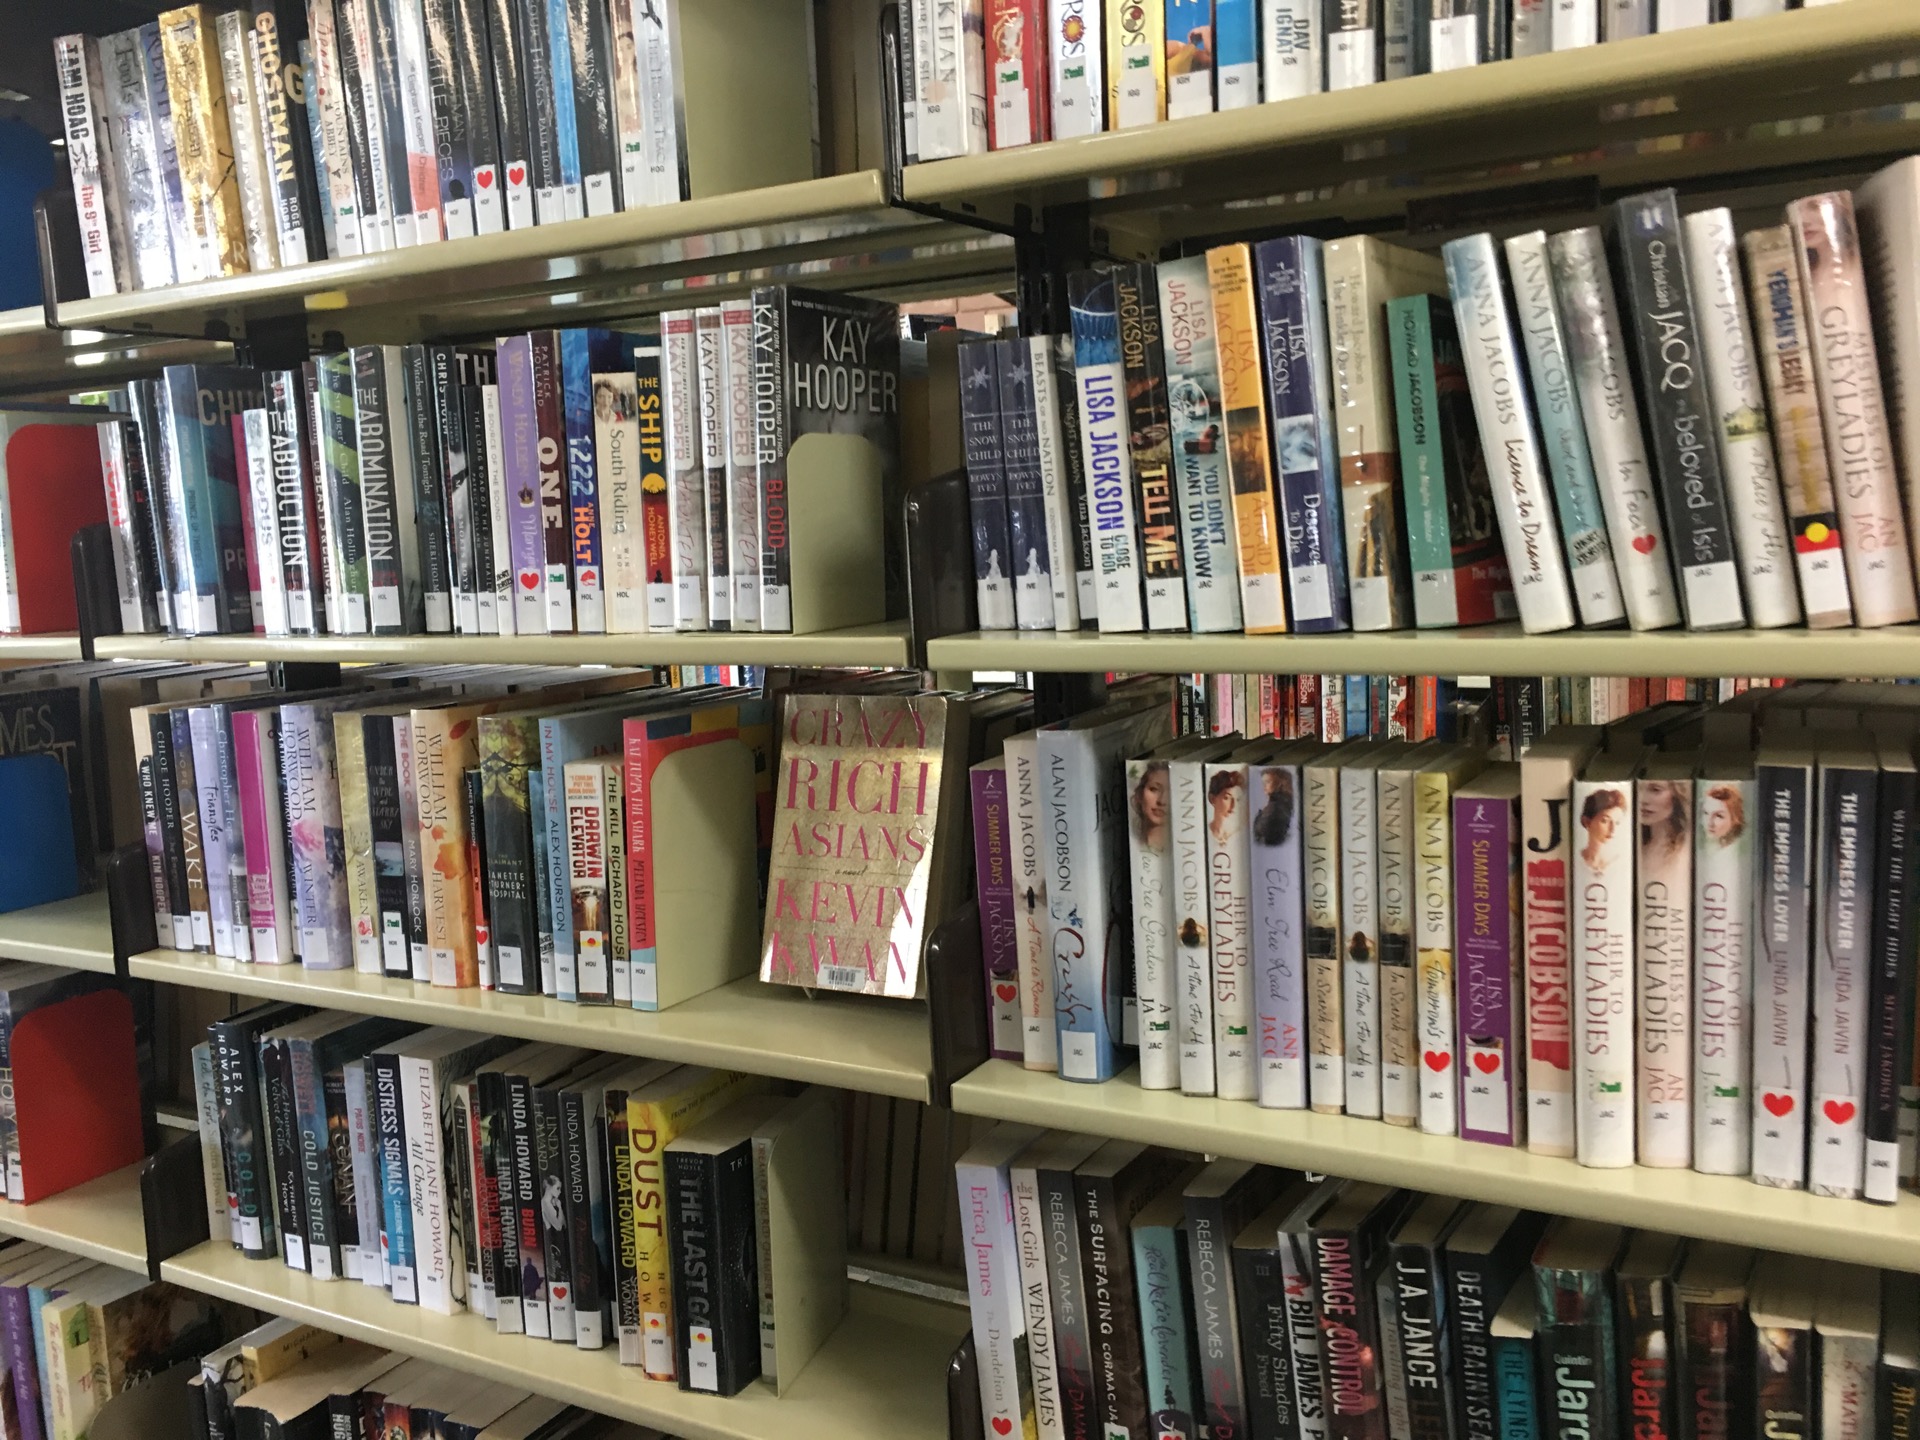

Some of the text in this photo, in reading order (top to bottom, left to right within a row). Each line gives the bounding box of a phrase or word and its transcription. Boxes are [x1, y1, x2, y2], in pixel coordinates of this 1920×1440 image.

[255, 12, 296, 184] GHOSTMAN
[1177, 76, 1190, 84] IGH
[1225, 76, 1238, 84] IGH
[1283, 57, 1297, 65] IGN
[437, 117, 454, 182] PIECES
[81, 184, 94, 209] The
[87, 231, 102, 255] Girl
[732, 328, 745, 371] KAY
[823, 316, 871, 364] KAY
[1120, 284, 1144, 368] JACKSON
[1142, 304, 1158, 345] LISA
[1168, 280, 1192, 366] JACKSON
[1190, 301, 1206, 341] LISA
[1648, 239, 1694, 389] Christian JACQ
[357, 388, 377, 405] THE
[413, 358, 422, 394] Witches
[534, 347, 544, 407] HOLLAND
[541, 347, 550, 400] PATRICK
[700, 333, 716, 457] KAY HOOPER
[754, 304, 776, 464] KAY HOOPER
[794, 363, 897, 414] HOOPER
[417, 414, 425, 428] the
[418, 431, 427, 457] Road
[639, 377, 661, 463] THE SHIP
[733, 374, 748, 457] HOOPER
[1034, 352, 1056, 496] BEASTS NATION
[1084, 375, 1124, 531] LISA JACKSON
[272, 435, 302, 566] ABDUCTION
[359, 409, 392, 561] ABOMINATION
[420, 459, 431, 495] Tonight
[538, 437, 563, 529] ONE
[570, 436, 592, 496] 1222
[610, 429, 628, 535] South Riding
[574, 507, 591, 562] HOLT
[648, 507, 657, 566] HONEYWELL
[766, 479, 784, 547] BLOOD
[1142, 466, 1178, 574] TELL ME
[1420, 573, 1437, 582] JAC
[544, 726, 552, 737] IN
[791, 709, 931, 748] CRAZY
[141, 766, 157, 835] WHO KNEW ME
[157, 731, 174, 830] CHLOE HOOPER
[284, 722, 301, 820] HORWOOD
[298, 728, 315, 812] WILLIAM
[415, 726, 432, 830] HORWOOD
[429, 734, 447, 822] WILLIAM
[547, 764, 556, 813] HOUSE
[785, 756, 933, 816] RICH
[181, 812, 202, 889] WAKE
[204, 783, 219, 843] Triangles
[585, 807, 603, 878] DARWIN
[780, 821, 925, 864] ASIANS
[988, 804, 1000, 852] SUMMER
[1017, 756, 1036, 876] ANNA JACOBS
[1051, 754, 1071, 891] ALAN JACOBSON
[1177, 777, 1201, 912] ANNA JACOBS
[1308, 779, 1328, 920] ANNA JACOBS
[1527, 800, 1567, 853] J
[407, 840, 421, 932] MARY HORLOCK
[551, 819, 565, 932] ALEX HOURSTON
[608, 777, 625, 960] THE KILL RICHARD HOUSE
[992, 855, 1002, 886] DAYS
[1421, 785, 1444, 933] ANNA JACOBS
[1472, 840, 1489, 897] SUMMER
[1772, 789, 1789, 942] THE EMPRESS LOVER
[432, 873, 446, 944] HARVEST
[776, 878, 918, 928] KEVIN
[1213, 853, 1236, 1002] GREYLADIES
[1235, 896, 1246, 967] HEIR TO
[1474, 902, 1490, 936] DAYS
[772, 931, 910, 985] KWAN
[1466, 952, 1487, 1032] JACKSON
[1489, 977, 1503, 1015] LISA
[1528, 891, 1569, 1043] JACOBSON
[1584, 884, 1609, 1057] GREYLADIES
[1644, 882, 1669, 1055] GREYLADIES
[1702, 883, 1726, 1058] GREYLADIES
[218, 1035, 232, 1105] HOWARD
[230, 1049, 243, 1093] ALEX
[378, 1068, 402, 1195] DISTRESS SIGNALS
[511, 1084, 533, 1200] LINDA HOWARD
[547, 1117, 559, 1159] LINDA
[566, 1101, 583, 1203] LINDA HOWARD
[288, 1171, 298, 1228] KATHERINE
[304, 1130, 325, 1241] COLD JUSTICE
[412, 1137, 424, 1216] All Change
[615, 1146, 635, 1268] LINDA HOWARD
[632, 1129, 662, 1237] DUST
[521, 1209, 536, 1248] BURN
[680, 1177, 707, 1283] THE LAST
[971, 1186, 993, 1296] Erica James
[1017, 1183, 1037, 1269] the Lost Girls
[1050, 1192, 1074, 1326] REBECCA JAMES
[1088, 1190, 1112, 1334] THE SURFACING
[1317, 1238, 1356, 1316] DAMAGE
[1457, 1270, 1485, 1334] DEATH
[1028, 1282, 1055, 1427] WENDY JAMES
[1267, 1305, 1288, 1426] Fifty Shades
